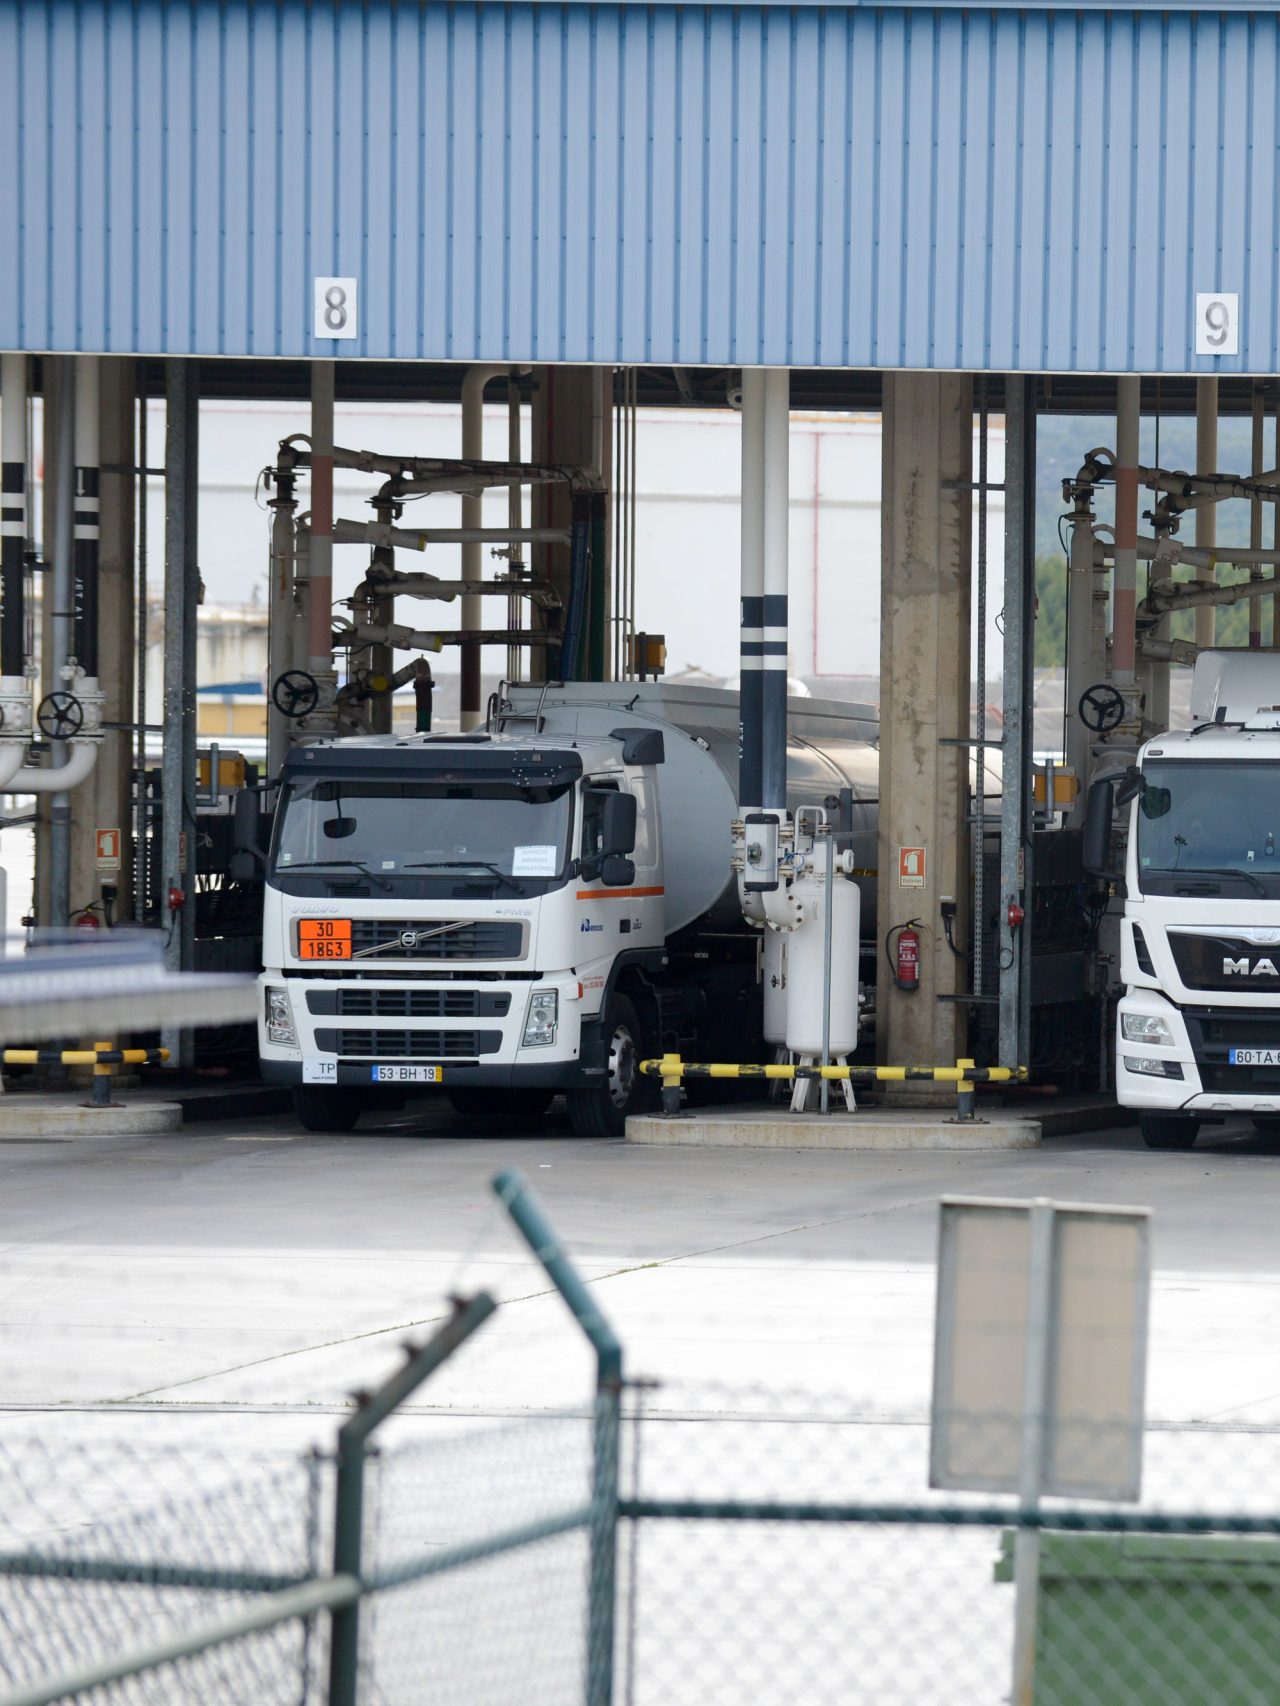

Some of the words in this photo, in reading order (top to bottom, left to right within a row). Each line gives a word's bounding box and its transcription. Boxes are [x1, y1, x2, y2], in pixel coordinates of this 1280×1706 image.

[324, 285, 347, 330] 8
[1204, 301, 1230, 346] 9
[316, 922, 334, 937] 30
[309, 942, 343, 957] 1863
[318, 1063, 335, 1074] TP
